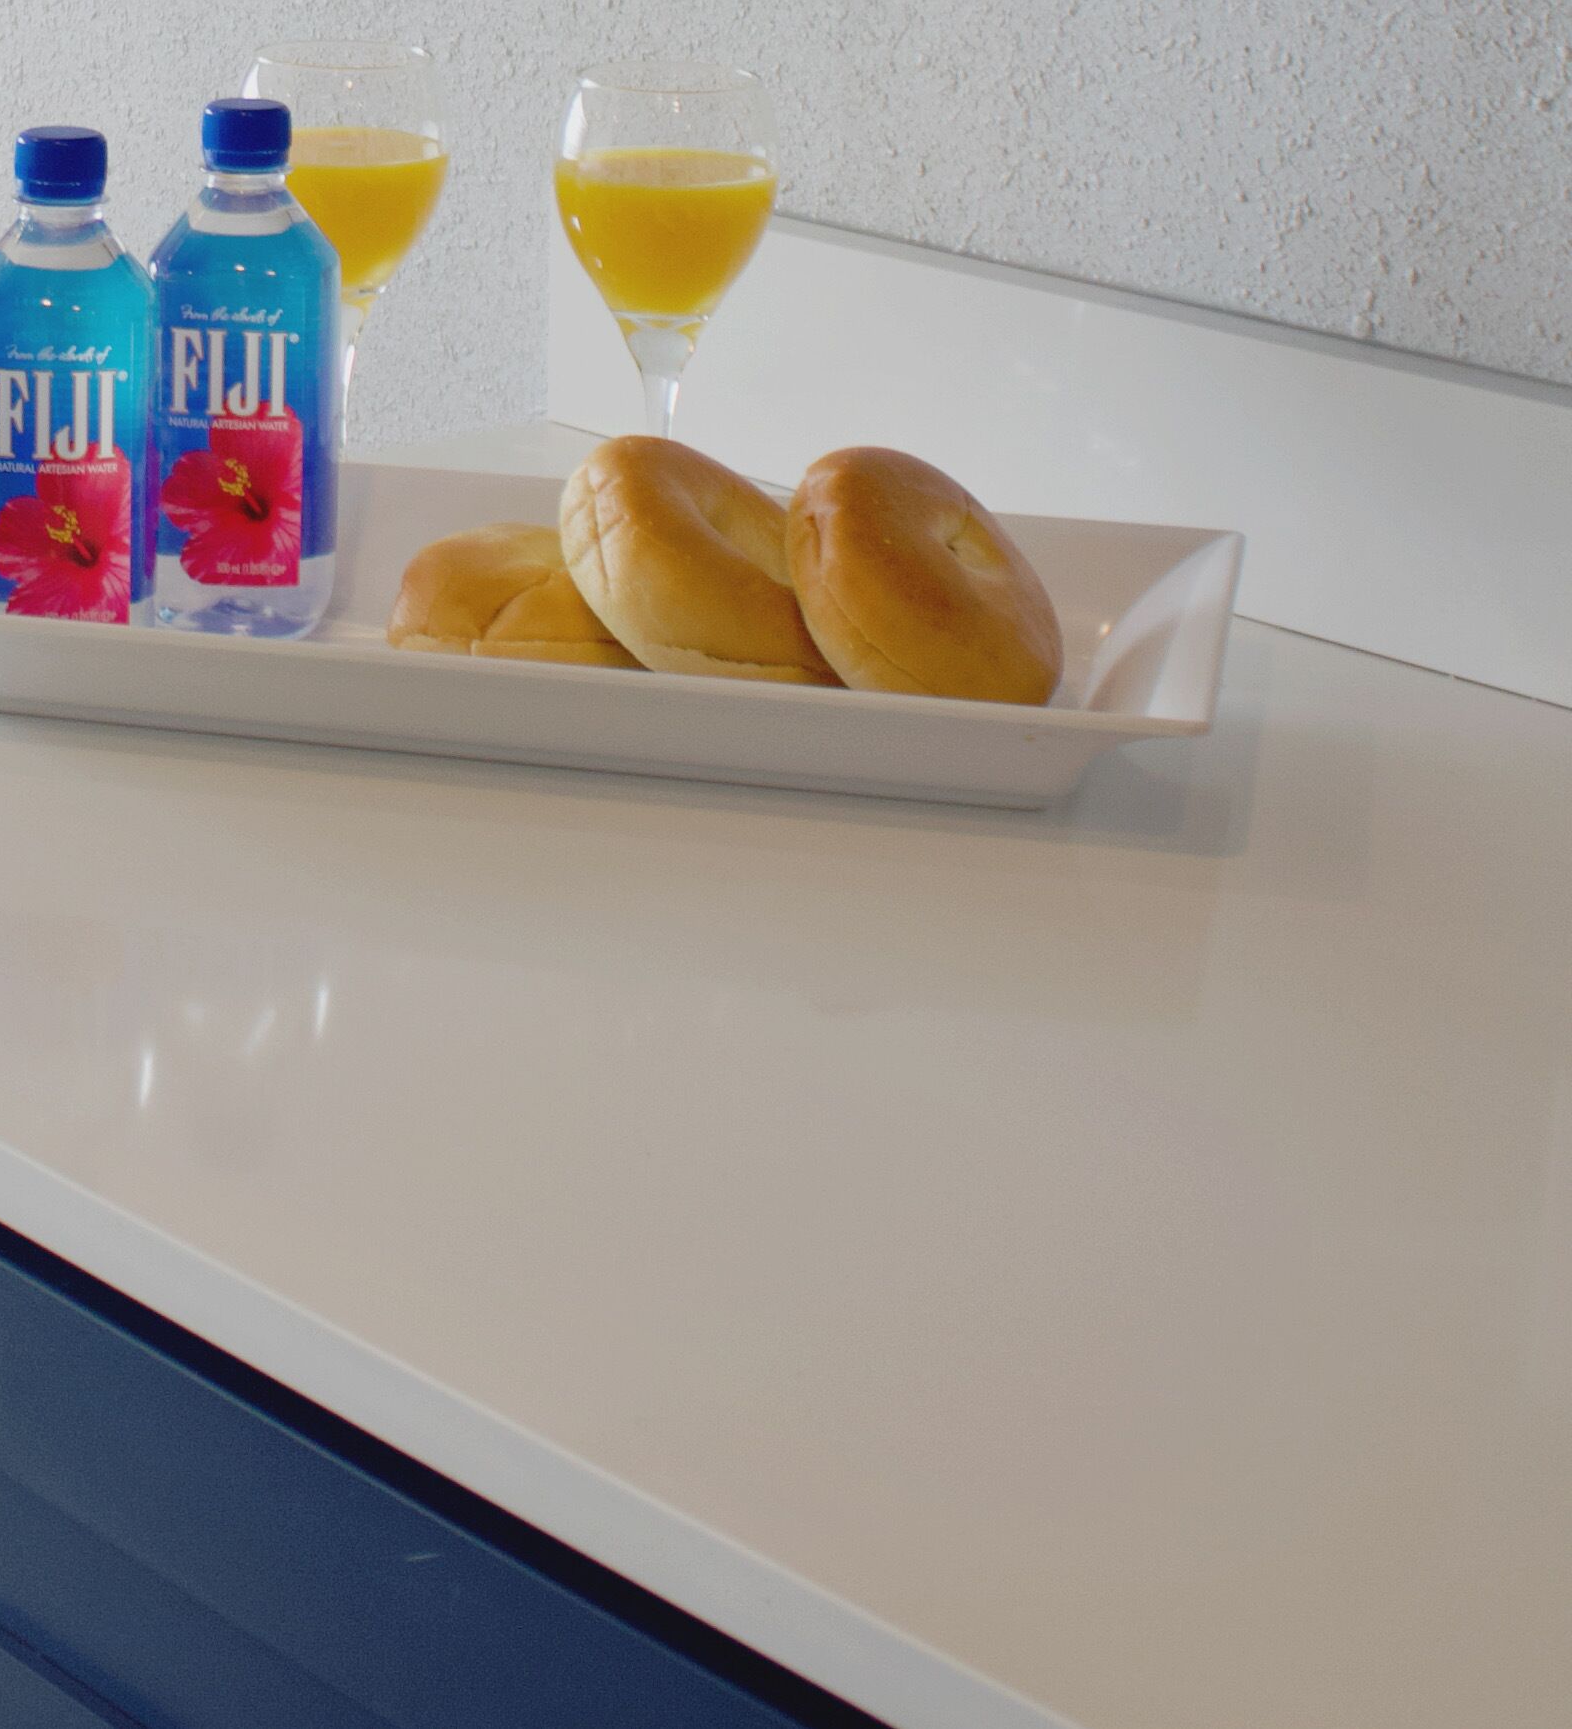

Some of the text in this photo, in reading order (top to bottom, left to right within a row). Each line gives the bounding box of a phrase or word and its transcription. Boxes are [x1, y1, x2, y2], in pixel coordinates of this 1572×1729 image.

[169, 327, 288, 418] FIJI
[169, 417, 289, 432] NATURAL ARTESIAN WATER
[38, 462, 86, 475] ARTESIAN
[86, 462, 118, 474] WATER
